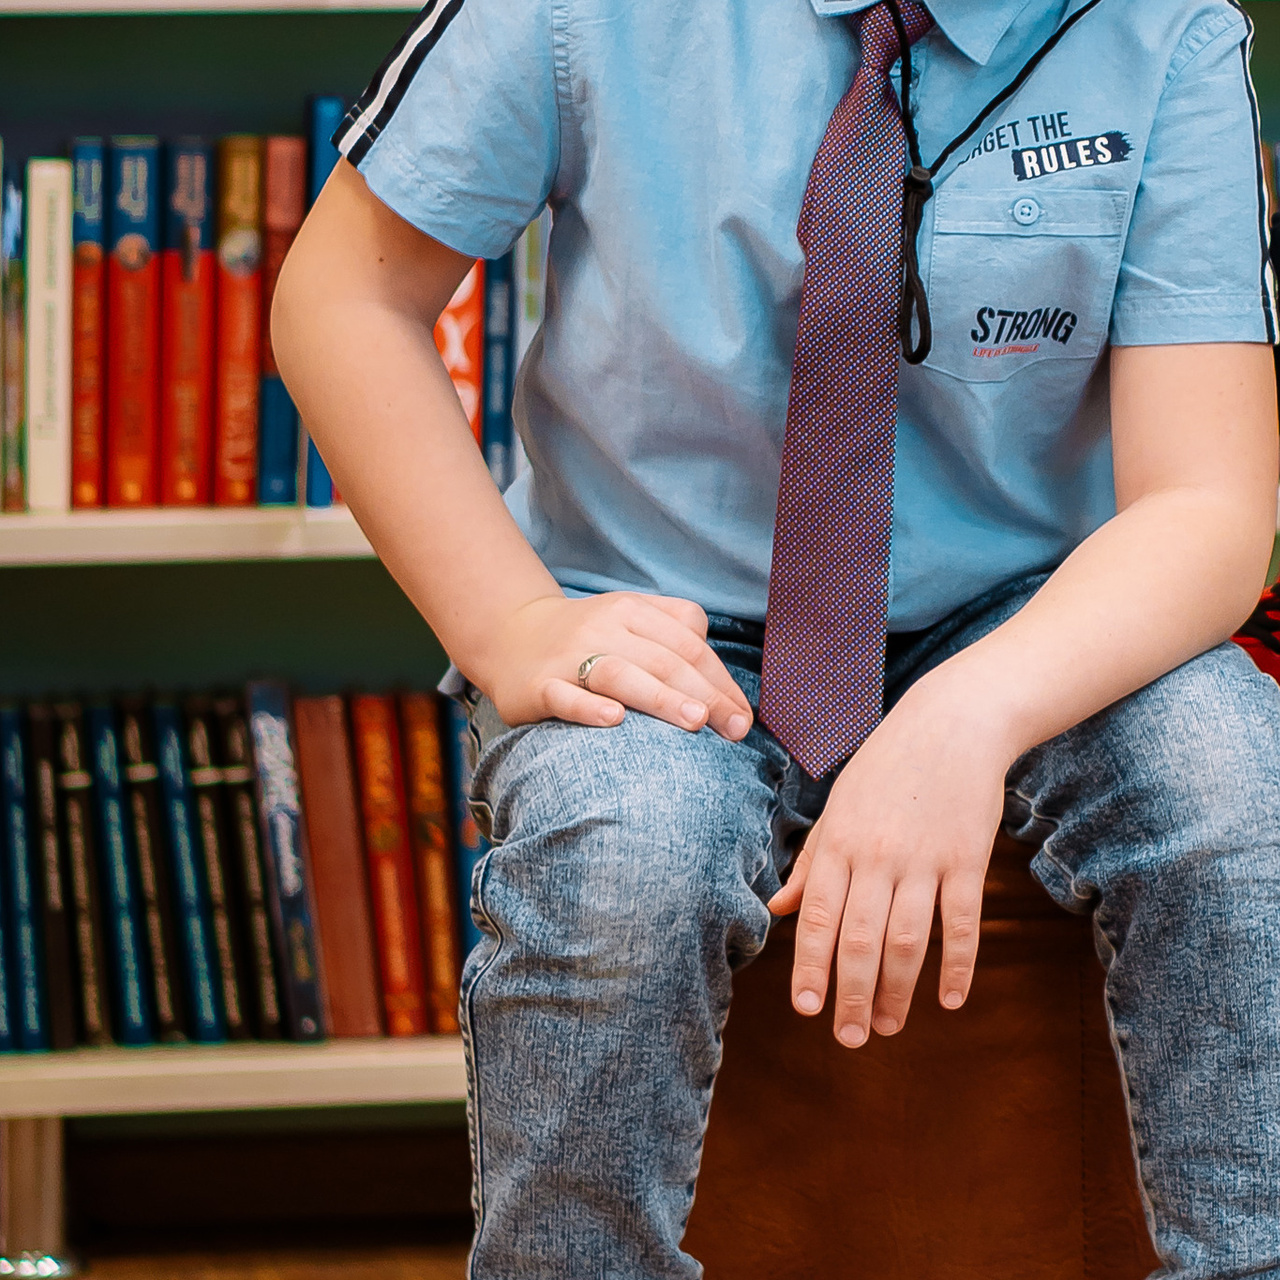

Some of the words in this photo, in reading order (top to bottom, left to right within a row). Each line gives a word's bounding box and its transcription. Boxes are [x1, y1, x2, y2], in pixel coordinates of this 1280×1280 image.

[957, 121, 1020, 166] RGET
[1027, 111, 1072, 143] THE
[1021, 136, 1112, 179] RULES
[971, 306, 1078, 345] STRONG
